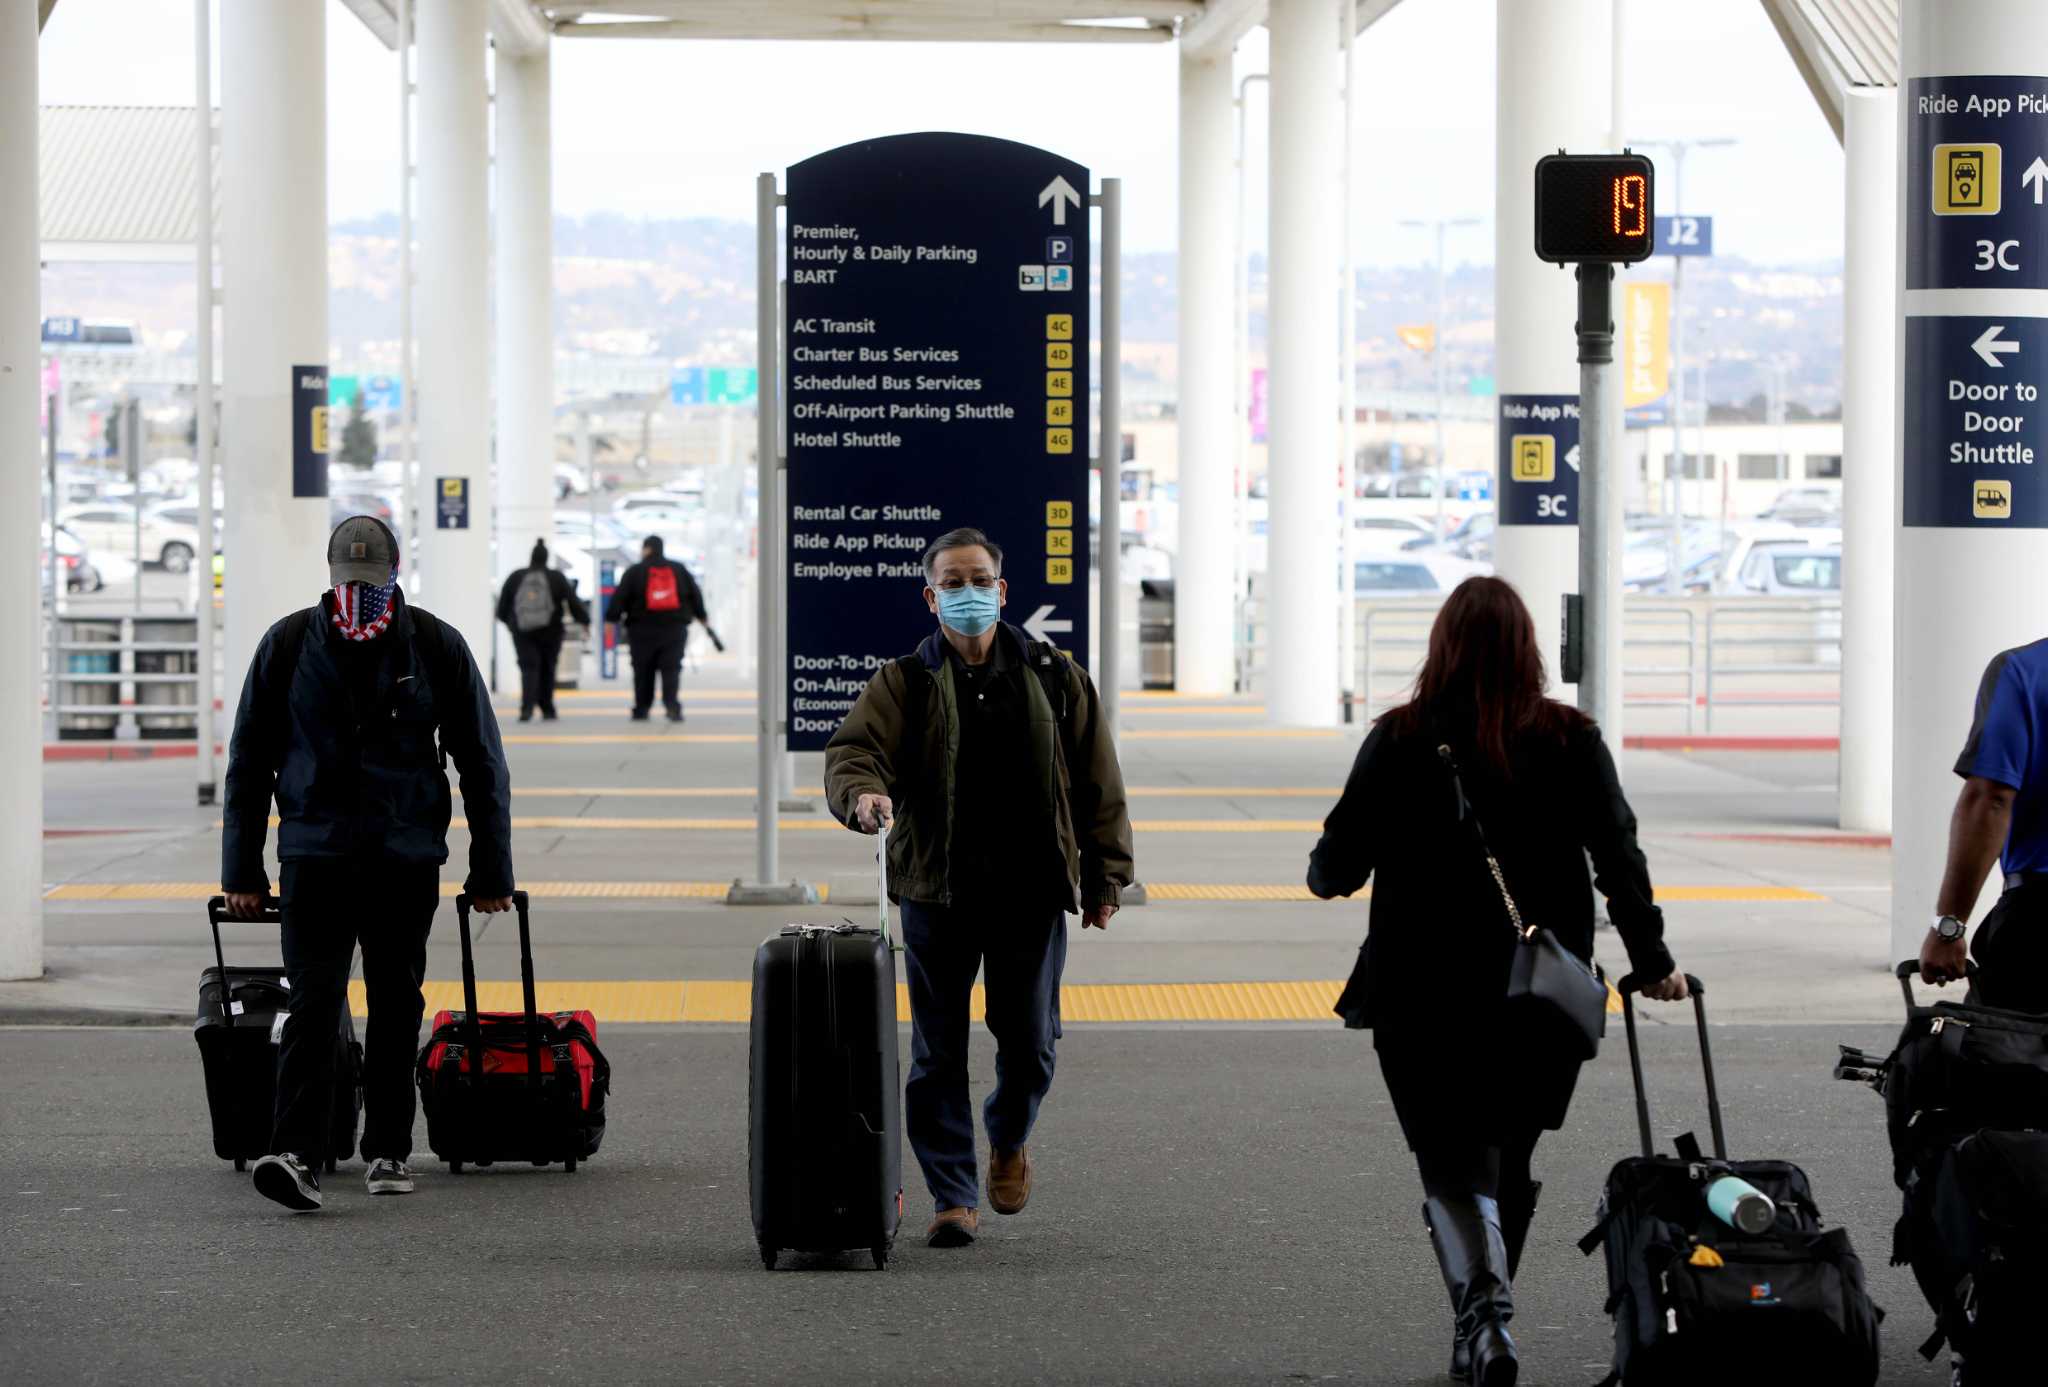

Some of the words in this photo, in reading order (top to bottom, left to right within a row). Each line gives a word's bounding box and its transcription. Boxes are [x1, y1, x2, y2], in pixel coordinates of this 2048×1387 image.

[1917, 94, 1958, 115] Ride
[1965, 94, 2011, 118] App
[1613, 174, 1646, 237] 19
[793, 224, 859, 241] Premier,
[1667, 217, 1699, 246] J2
[793, 245, 848, 263] Hourly
[852, 245, 866, 260] &
[871, 245, 911, 263] Daily
[916, 245, 978, 263] Parking
[1974, 239, 2020, 271] 3C
[793, 269, 837, 284] BART
[793, 318, 817, 333] AC
[821, 318, 876, 333] Transit
[1051, 320, 1068, 333] 4C
[793, 346, 854, 362] Charter
[859, 346, 889, 362] Bus
[894, 346, 959, 362] Services
[1050, 349, 1069, 361] 4D
[793, 375, 877, 390] Scheduled
[882, 375, 911, 390] Bus
[916, 375, 982, 390] Services
[1051, 377, 1067, 390] 4E
[1949, 380, 2008, 401] Door
[2014, 382, 2038, 401] to
[793, 402, 885, 422] Off-Airport
[890, 402, 950, 422] Parking
[955, 402, 1014, 419] Shuttle
[1052, 406, 1067, 417] 4F
[1503, 404, 1529, 418] Ride
[1530, 404, 1561, 421] App
[1964, 411, 2024, 432] Door
[793, 431, 837, 447] Hotel
[842, 431, 902, 447] Shuttle
[1050, 434, 1069, 446] 4G
[1950, 441, 2035, 465] Shuttle
[793, 505, 846, 521] Rental
[850, 505, 878, 521] Car
[882, 505, 942, 521] Shuttle
[1050, 507, 1069, 519] 3D
[1537, 494, 1568, 517] 3C
[793, 533, 830, 549] Ride
[833, 533, 868, 553] App
[873, 533, 926, 553] Pickup
[1051, 535, 1069, 548] 3C
[793, 562, 873, 581] Employee
[1051, 564, 1068, 576] 3B
